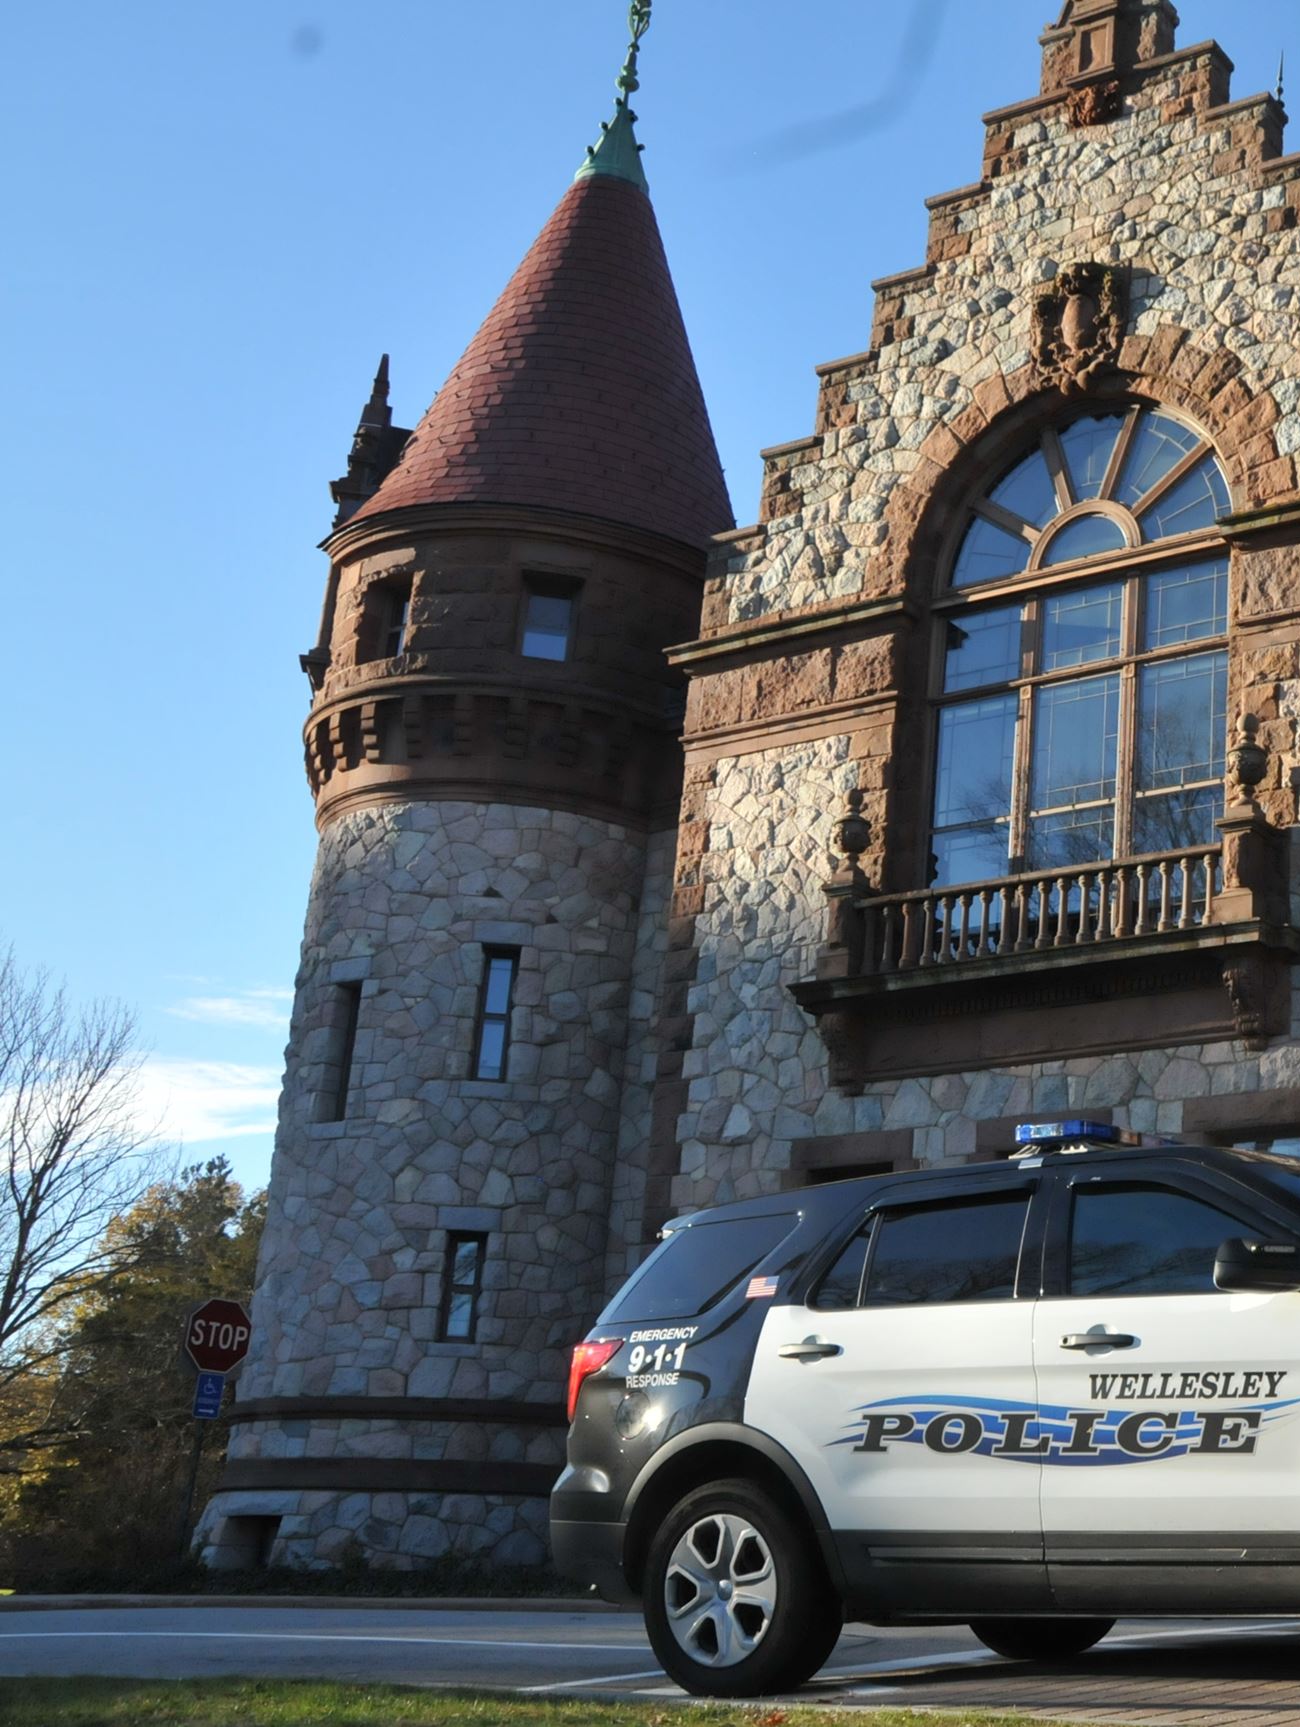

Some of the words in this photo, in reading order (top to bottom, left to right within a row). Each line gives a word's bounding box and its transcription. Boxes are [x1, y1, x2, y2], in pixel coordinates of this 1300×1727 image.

[191, 1318, 249, 1352] STOP
[629, 1325, 699, 1343] EMERGENCY
[625, 1372, 680, 1389] RESPONSE
[1089, 1370, 1287, 1400] WELLESLEY
[852, 1409, 1264, 1456] POLICE
